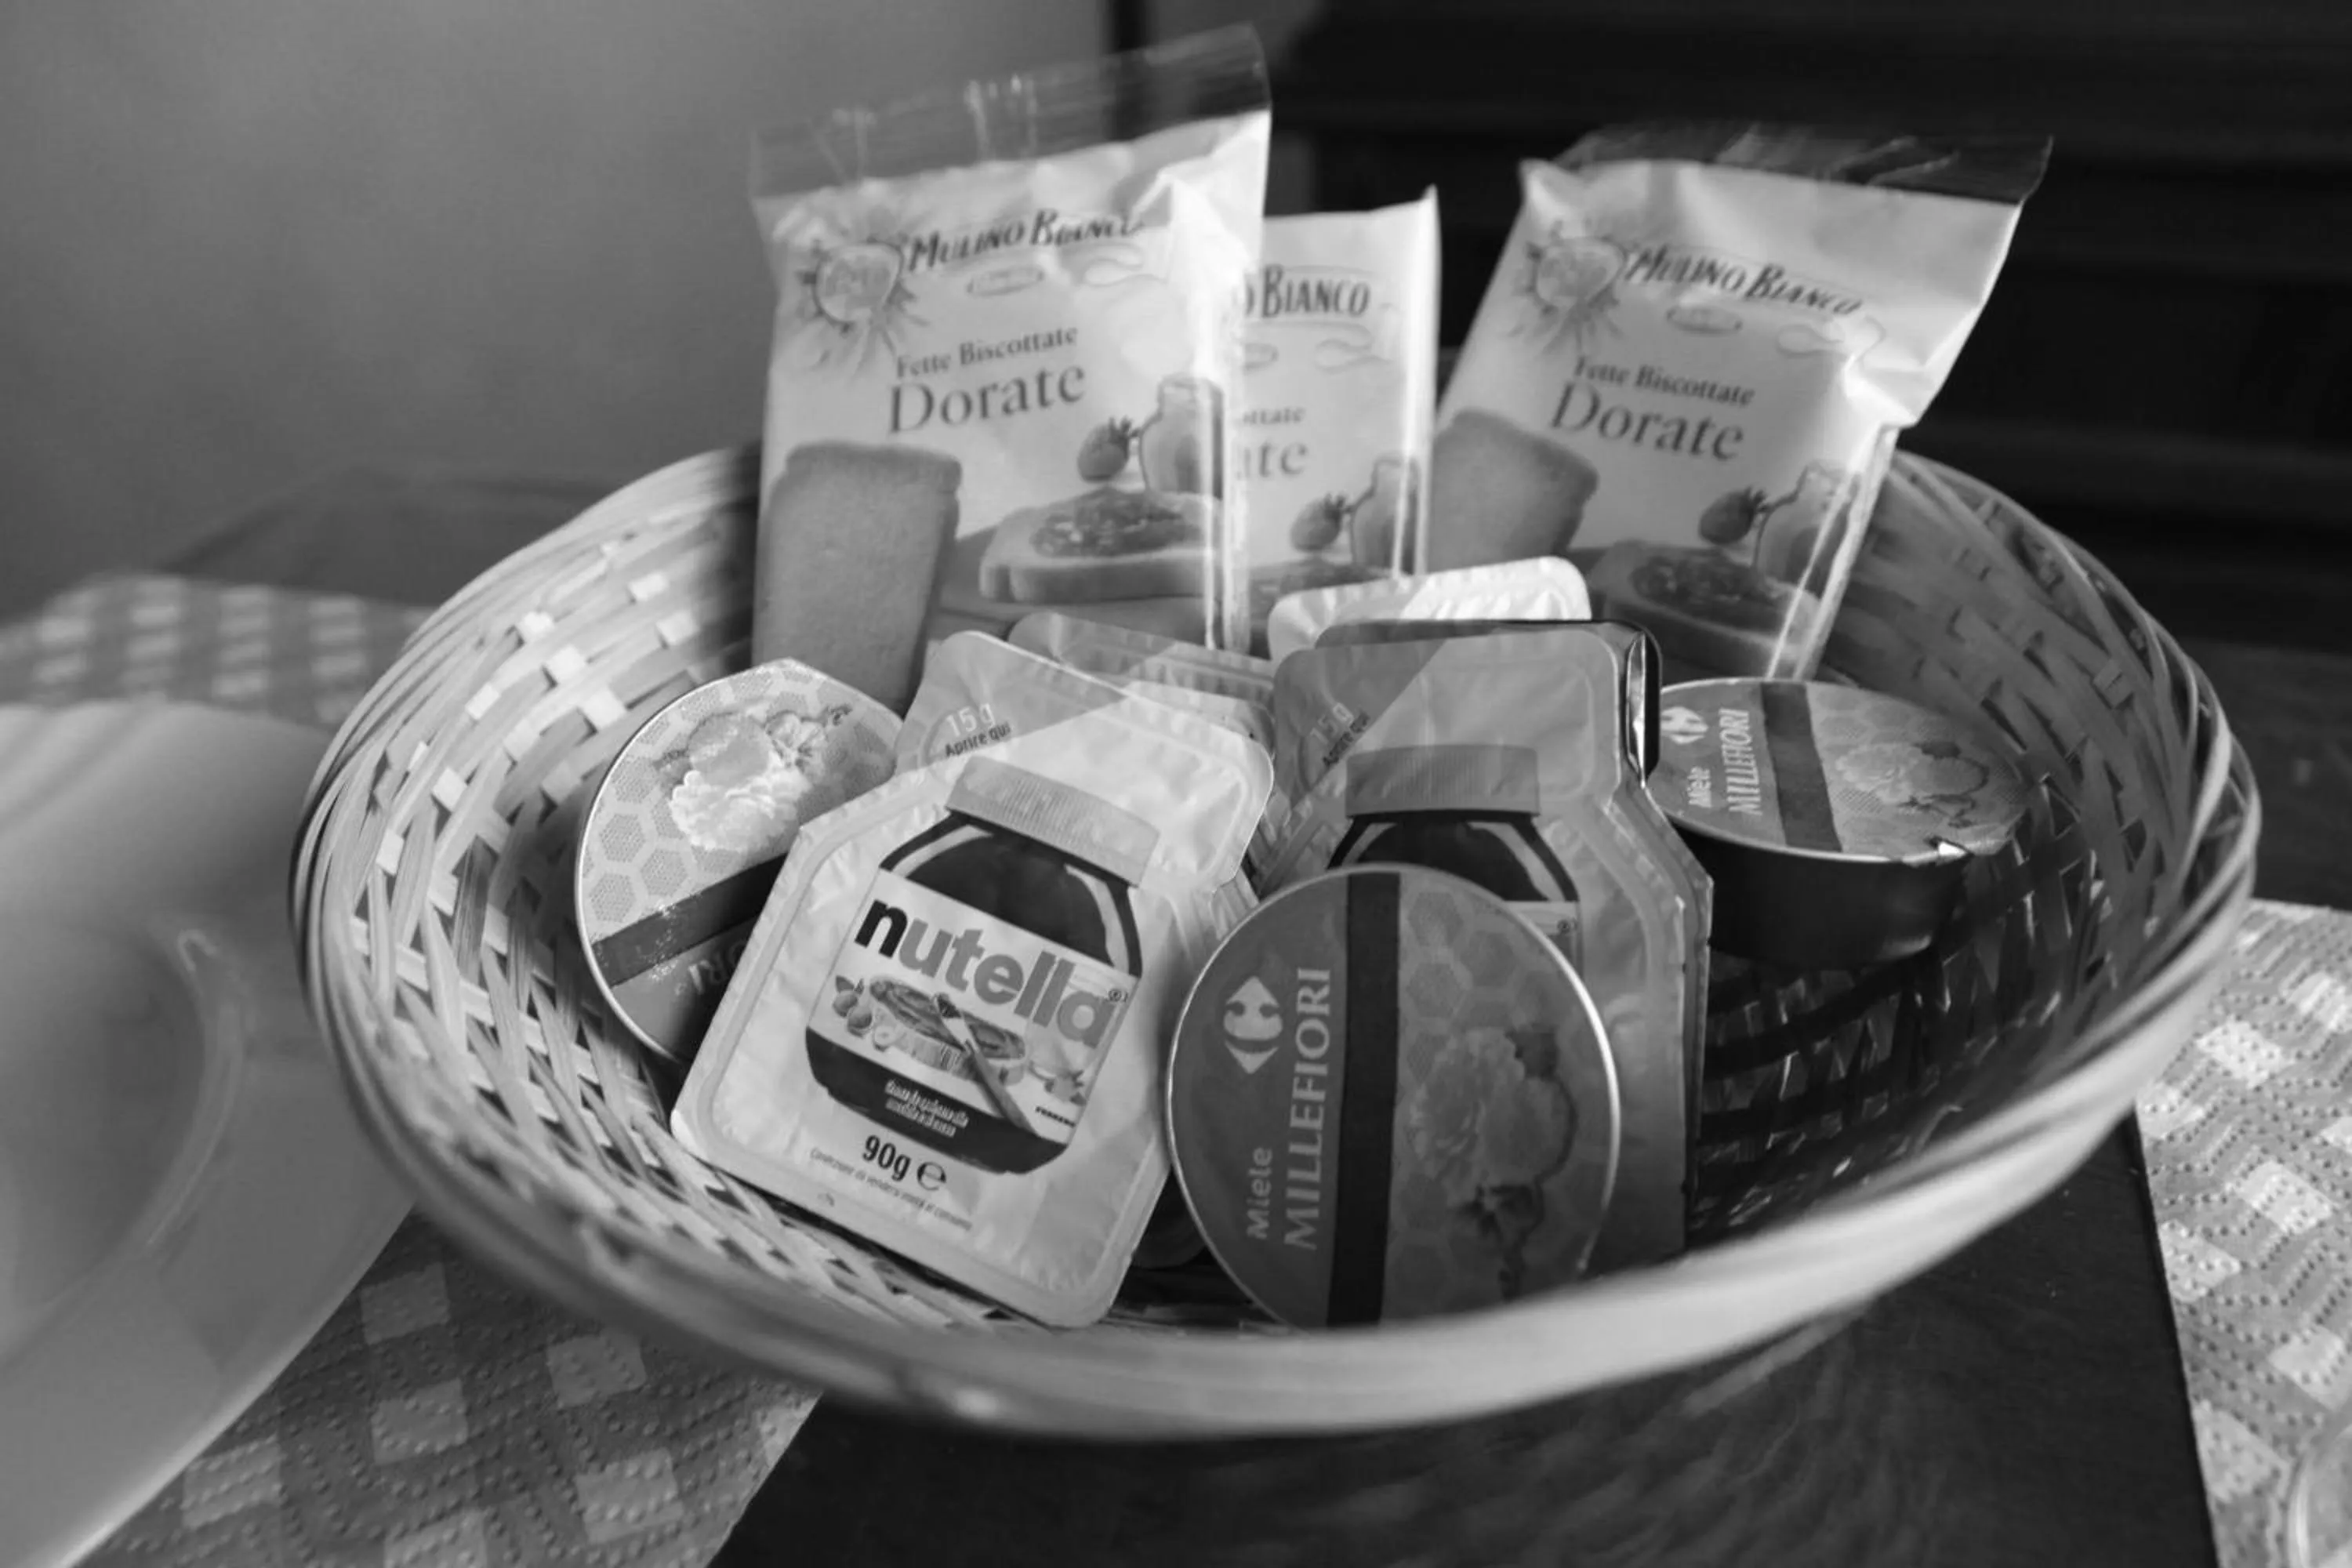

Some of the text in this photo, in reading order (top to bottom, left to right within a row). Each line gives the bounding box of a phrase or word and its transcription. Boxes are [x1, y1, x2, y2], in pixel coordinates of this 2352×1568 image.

[1261, 263, 1371, 318] BIANCO
[897, 325, 1078, 379] Fette Biscottate
[1573, 356, 1755, 408] Fette Biscottate
[889, 363, 1087, 435] Dorate
[1551, 380, 1744, 461] Dorate
[1718, 708, 1763, 817] MILLEFIORI
[855, 898, 1118, 1051] nutella
[1283, 967, 1331, 1250] MILLEFIORI
[862, 1134, 911, 1181] 90g
[1247, 1146, 1273, 1240] Miele
